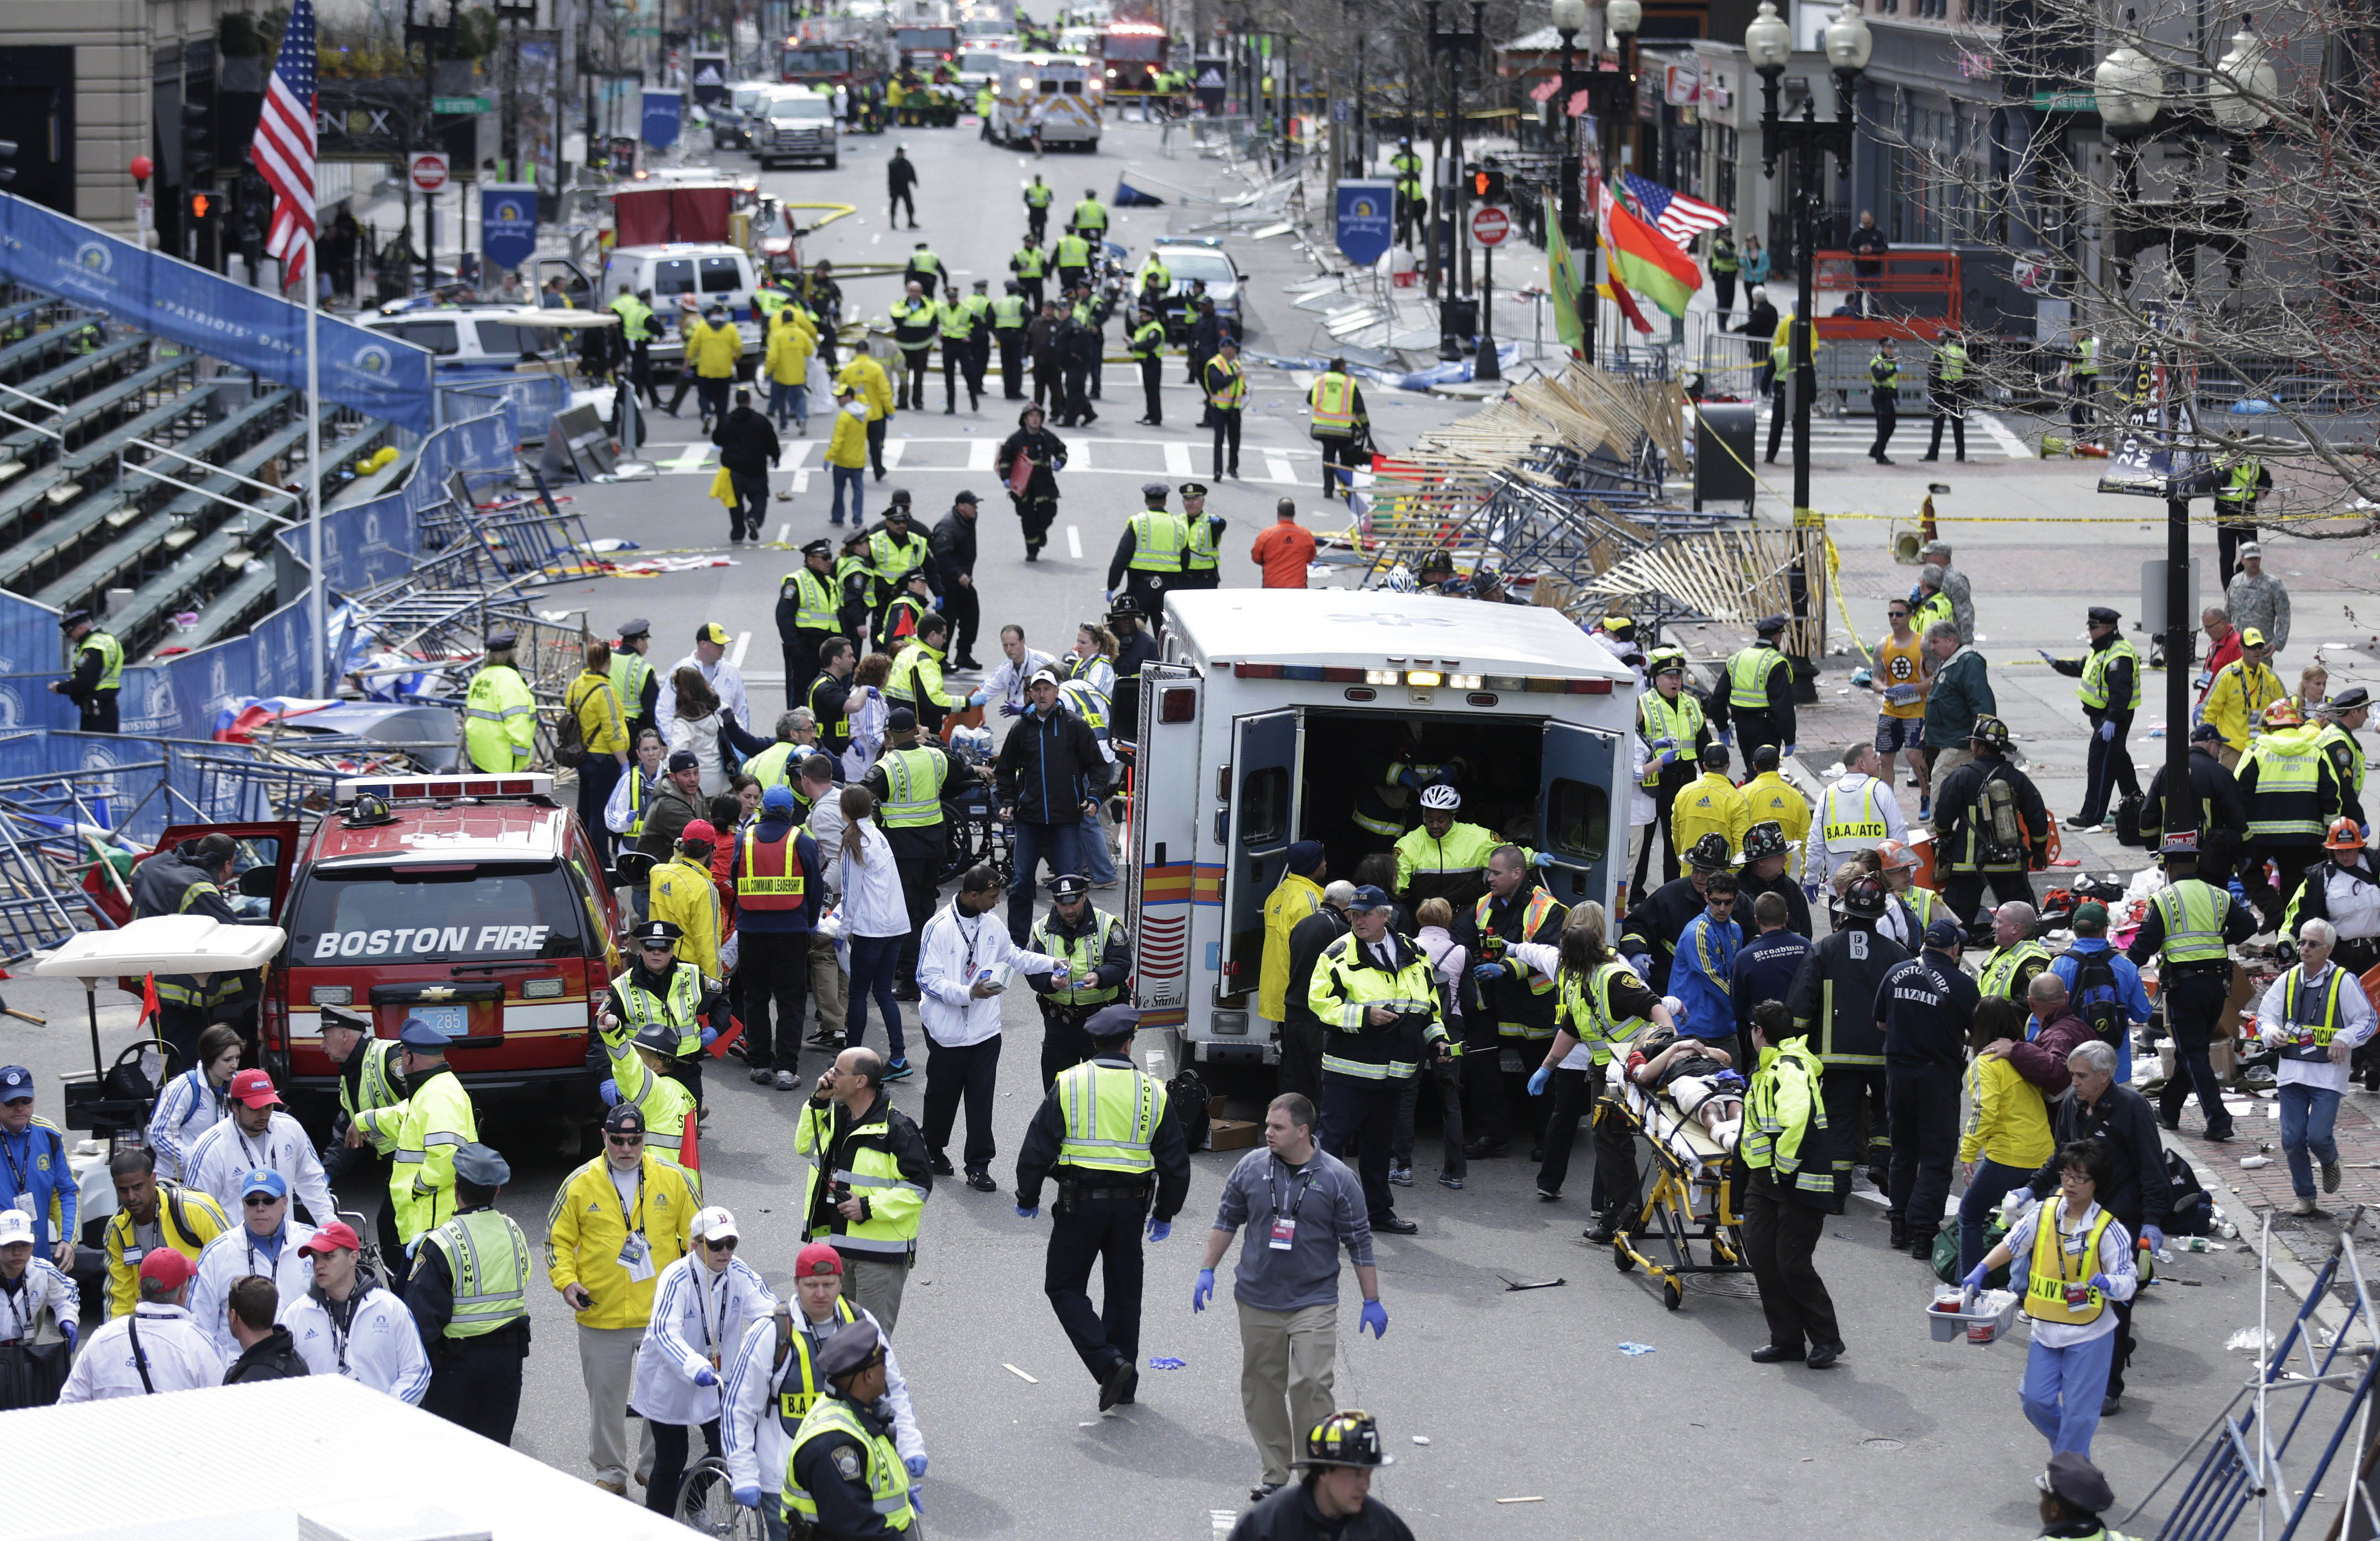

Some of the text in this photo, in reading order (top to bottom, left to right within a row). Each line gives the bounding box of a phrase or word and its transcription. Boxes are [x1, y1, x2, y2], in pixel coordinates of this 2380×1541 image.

[317, 110, 391, 135] ENOX
[258, 334, 294, 354] DAY
[2135, 310, 2151, 405] BOSTN
[2117, 413, 2144, 465] 203
[120, 719, 160, 733] BOSTON
[894, 762, 907, 799] BOSTON
[1826, 825, 1881, 840] B.A.A./ATC
[751, 880, 772, 893] COMMAND
[774, 879, 801, 893] LEADERSHIP
[2166, 890, 2181, 924] OSTON
[2214, 889, 2224, 922] OLICE
[314, 925, 550, 958] BOSTON FIRE
[1092, 931, 1101, 968] OLICE
[1752, 945, 1804, 960] Broadway
[1891, 965, 1950, 995] BOSTO FIRE
[1894, 987, 1941, 1006] HAZMAT
[436, 1015, 461, 1028] 285
[1140, 1078, 1151, 1132] POLICE
[451, 1226, 473, 1283] BOSTON
[512, 1225, 526, 1276] OLICE
[125, 1359, 152, 1370] adas
[1362, 1431, 1376, 1453] 7
